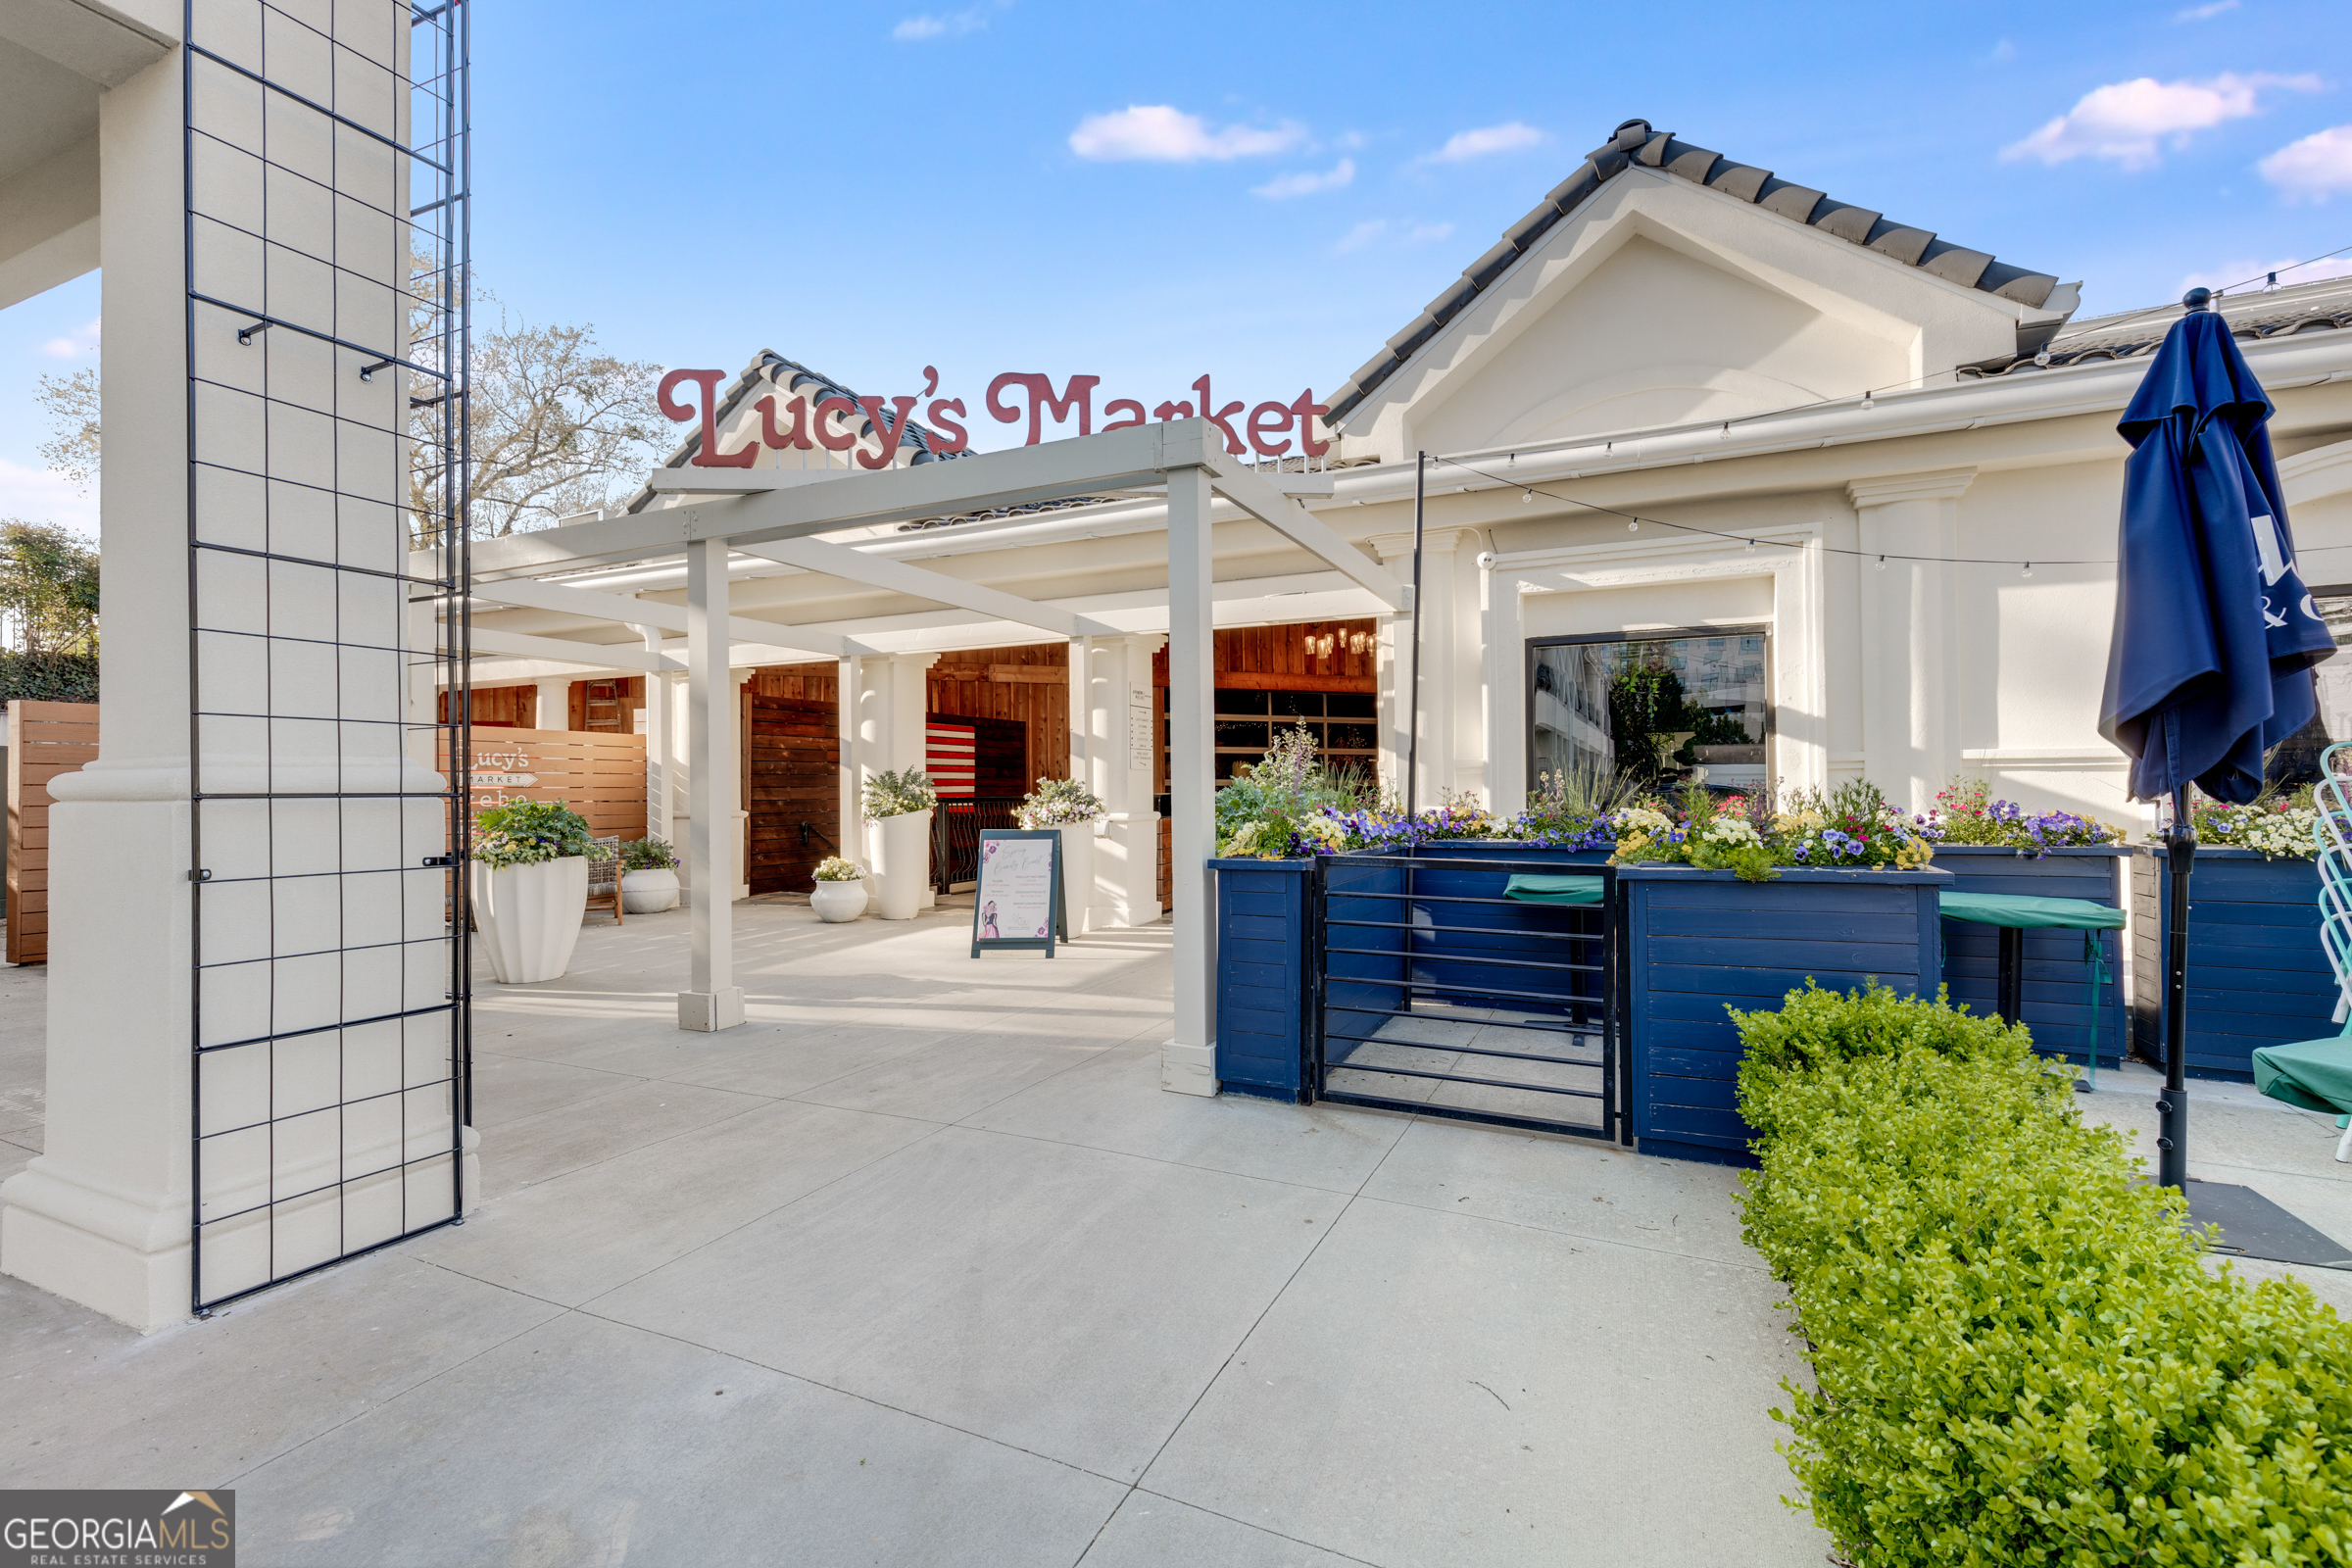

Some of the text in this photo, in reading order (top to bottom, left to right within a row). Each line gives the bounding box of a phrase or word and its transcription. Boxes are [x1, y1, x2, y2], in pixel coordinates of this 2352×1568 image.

[658, 365, 1330, 468] Lucy's Market
[1003, 846, 1026, 859] Spring
[994, 860, 1018, 876] Beauty
